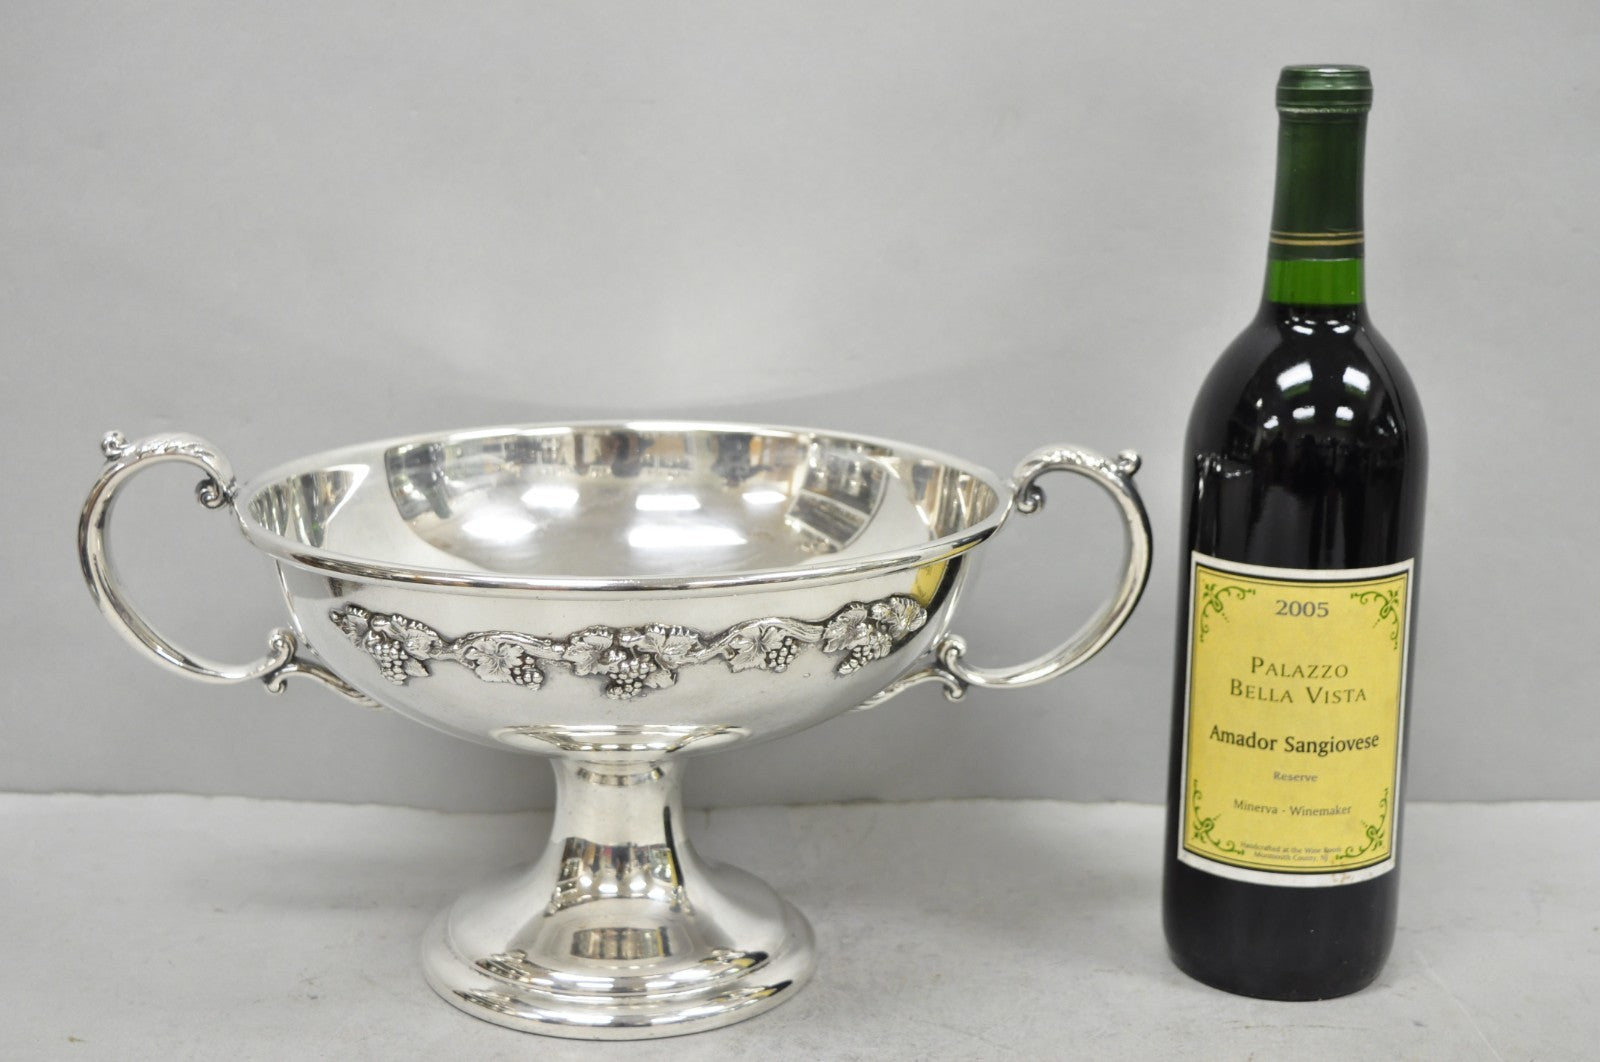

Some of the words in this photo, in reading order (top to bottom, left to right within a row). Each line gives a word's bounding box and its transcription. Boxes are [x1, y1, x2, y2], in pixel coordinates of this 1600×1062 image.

[1275, 600, 1329, 618] 2005
[1209, 724, 1277, 751] Amador
[1284, 734, 1380, 757] Sangiovese
[1273, 771, 1318, 782] Reserve
[1233, 798, 1278, 815] Minerva
[1289, 805, 1352, 817] Winemaker
